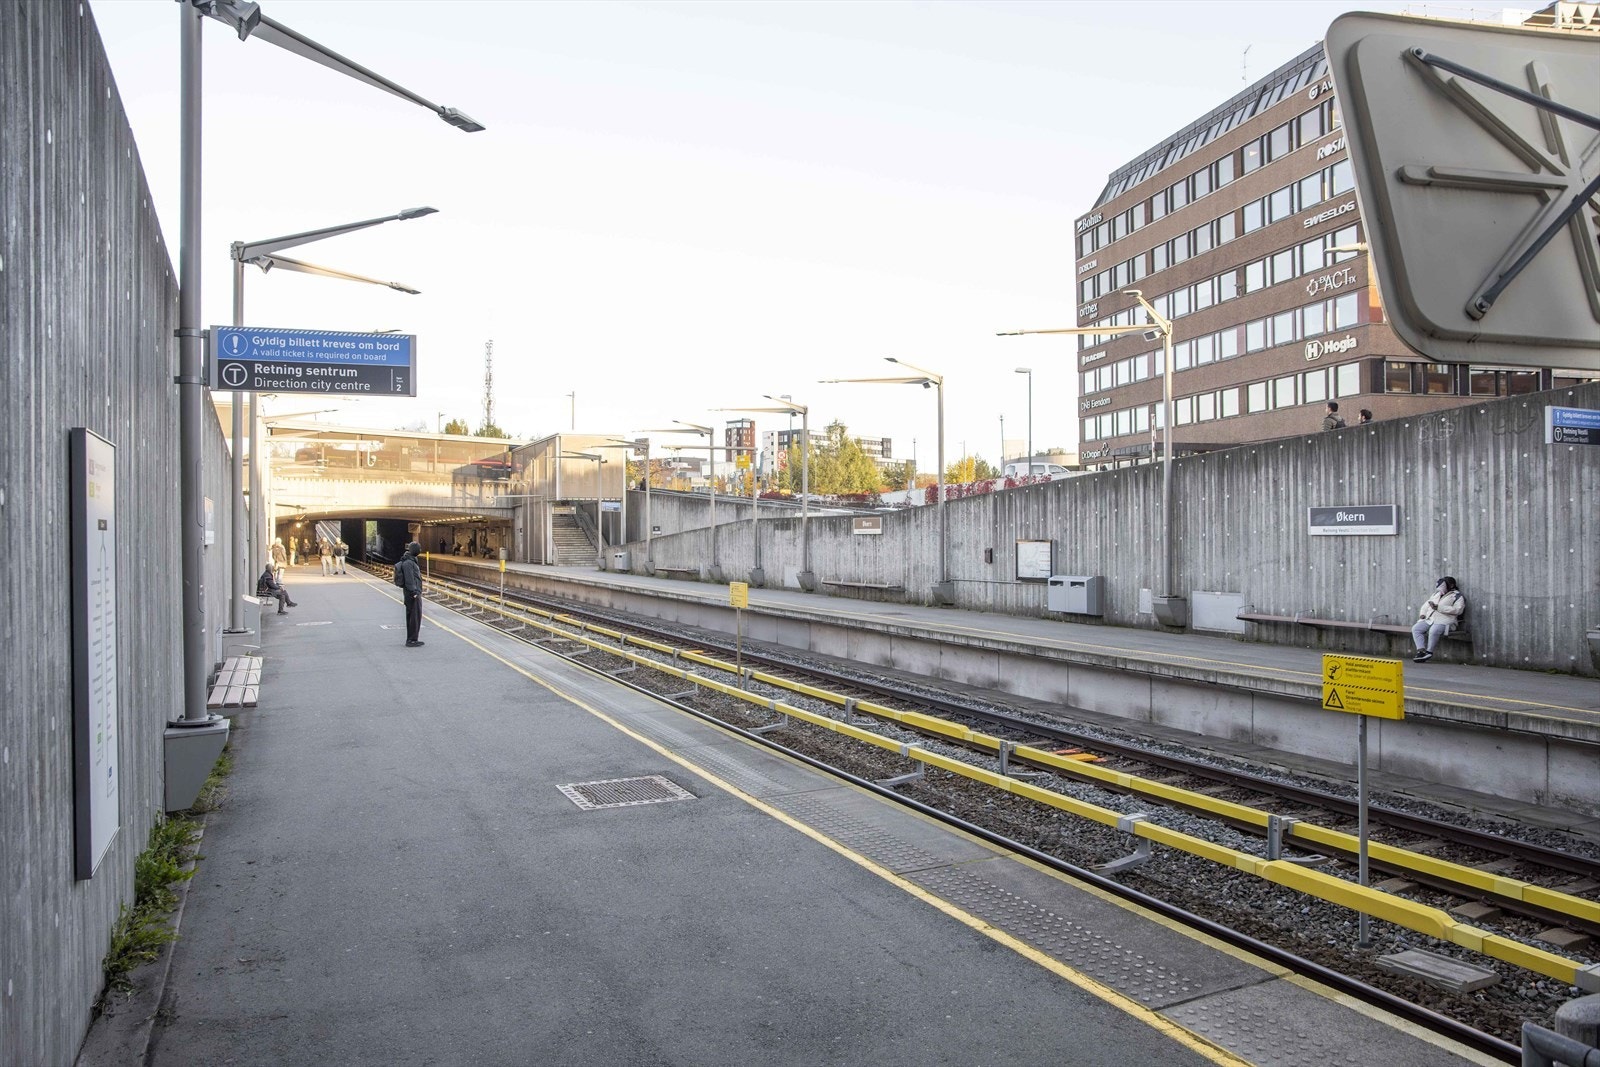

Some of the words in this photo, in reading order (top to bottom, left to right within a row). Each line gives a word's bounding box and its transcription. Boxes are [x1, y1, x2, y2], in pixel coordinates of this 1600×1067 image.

[1303, 200, 1355, 229] SWISSLOG
[1080, 302, 1098, 317] orthex
[252, 335, 286, 348] Gyldig
[289, 337, 320, 348] billett
[323, 339, 356, 349] kreves
[358, 342, 374, 350] om
[376, 341, 400, 351] bord
[1324, 335, 1357, 354] Hogia
[252, 348, 258, 356] A
[261, 348, 280, 357] valid
[282, 349, 305, 358] ticket
[307, 350, 314, 358] is
[315, 351, 350, 360] required
[363, 352, 387, 361] board
[254, 363, 303, 378] Retning
[306, 366, 358, 377] sentrum
[254, 376, 308, 389] Direction
[311, 379, 332, 392] city
[334, 380, 371, 391] centre
[396, 384, 402, 392] 2
[1336, 511, 1365, 522] Økern
